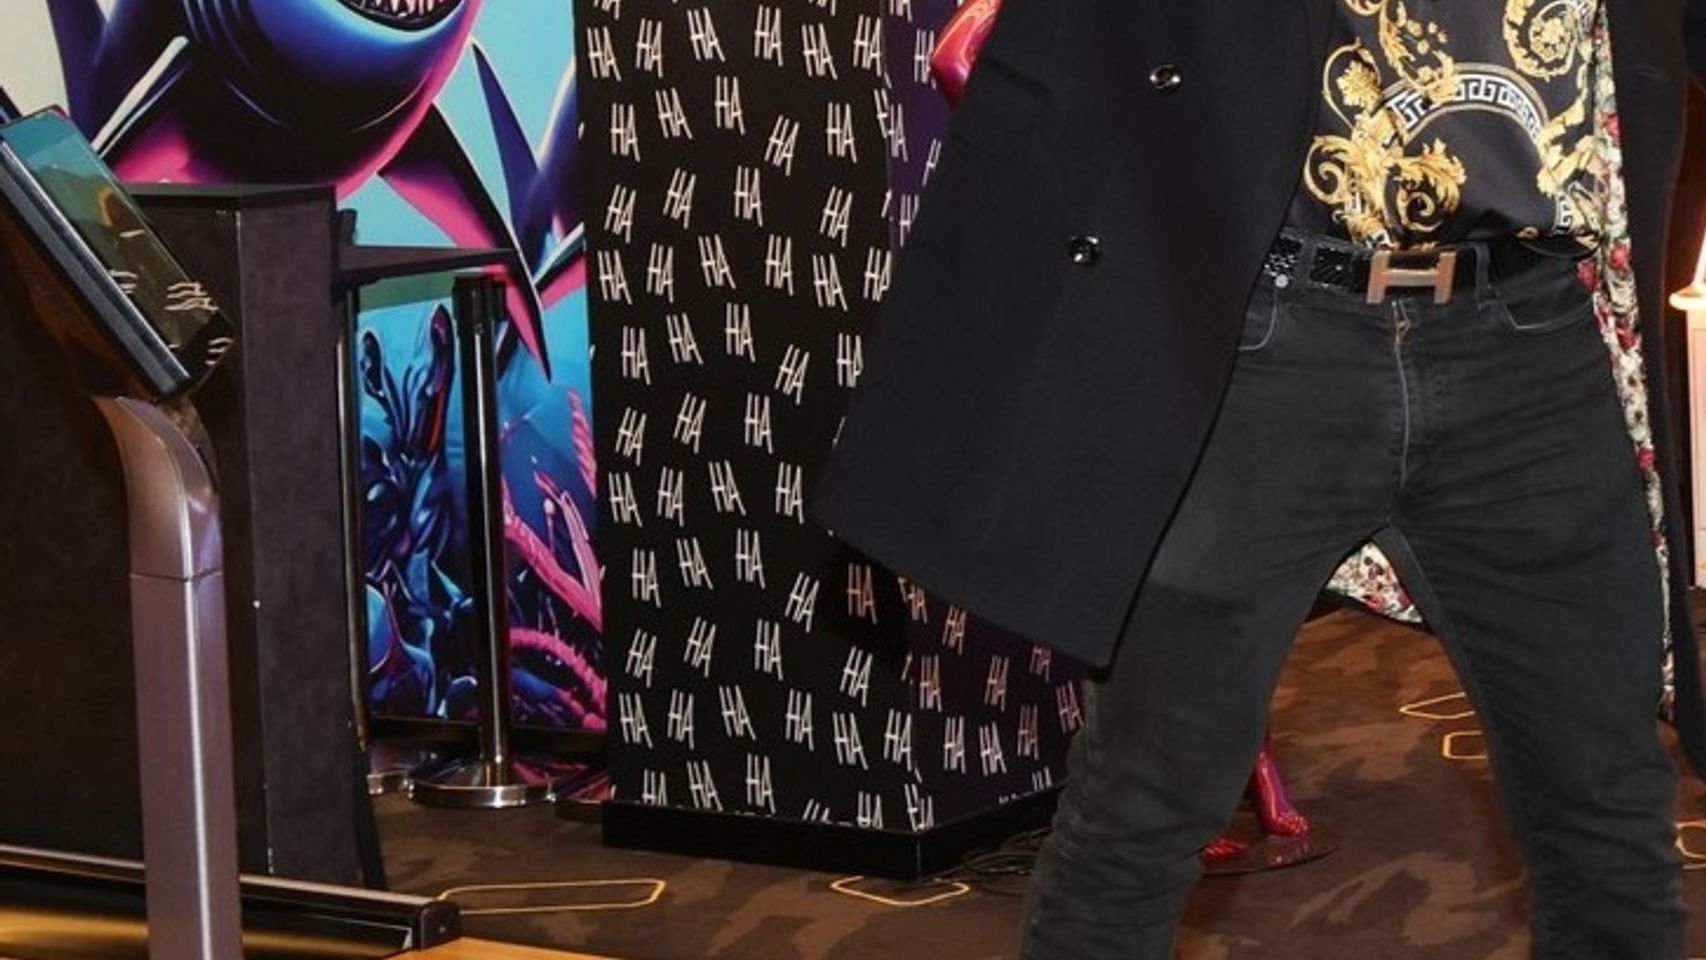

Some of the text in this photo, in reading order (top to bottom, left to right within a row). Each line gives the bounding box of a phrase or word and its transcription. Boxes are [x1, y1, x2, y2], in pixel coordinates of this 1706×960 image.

[586, 25, 622, 83] HA
[634, 17, 664, 79] HA
[686, 6, 726, 63] HA
[800, 22, 839, 81] HA
[852, 13, 884, 78] HA
[609, 101, 641, 163] HA
[654, 86, 694, 140] HA
[713, 74, 747, 136] HA
[824, 101, 858, 164] HA
[603, 183, 637, 245] HA
[662, 166, 697, 231] HA
[732, 164, 764, 228] HA
[819, 185, 854, 249] HA
[645, 242, 675, 304] HA
[697, 233, 738, 290] HA
[764, 233, 795, 297] HA
[811, 252, 849, 313] HA
[620, 325, 652, 386] HA
[665, 311, 705, 366] HA
[723, 301, 757, 364] HA
[773, 343, 811, 406] HA
[672, 391, 707, 455] HA
[743, 391, 774, 455] HA
[607, 471, 644, 528] HA
[656, 465, 685, 528] HA
[707, 459, 747, 517] HA
[774, 461, 805, 525] HA
[630, 547, 662, 609] HA
[734, 527, 766, 590] HA
[784, 571, 820, 634] HA
[846, 563, 878, 624] HA
[624, 627, 658, 689] HA
[683, 616, 717, 679] HA
[753, 618, 784, 682] HA
[941, 605, 967, 655] HA
[838, 645, 874, 708] HA
[919, 654, 943, 713] HA
[984, 654, 1010, 712] HA
[1056, 681, 1084, 733] HA
[617, 692, 654, 750] HA
[666, 688, 695, 751] HA
[718, 684, 757, 741] HA
[831, 711, 869, 771] HA
[883, 707, 913, 773] HA
[1016, 705, 1039, 761] HA
[943, 715, 967, 775] HA
[978, 721, 1008, 777] HA
[685, 759, 724, 813] HA
